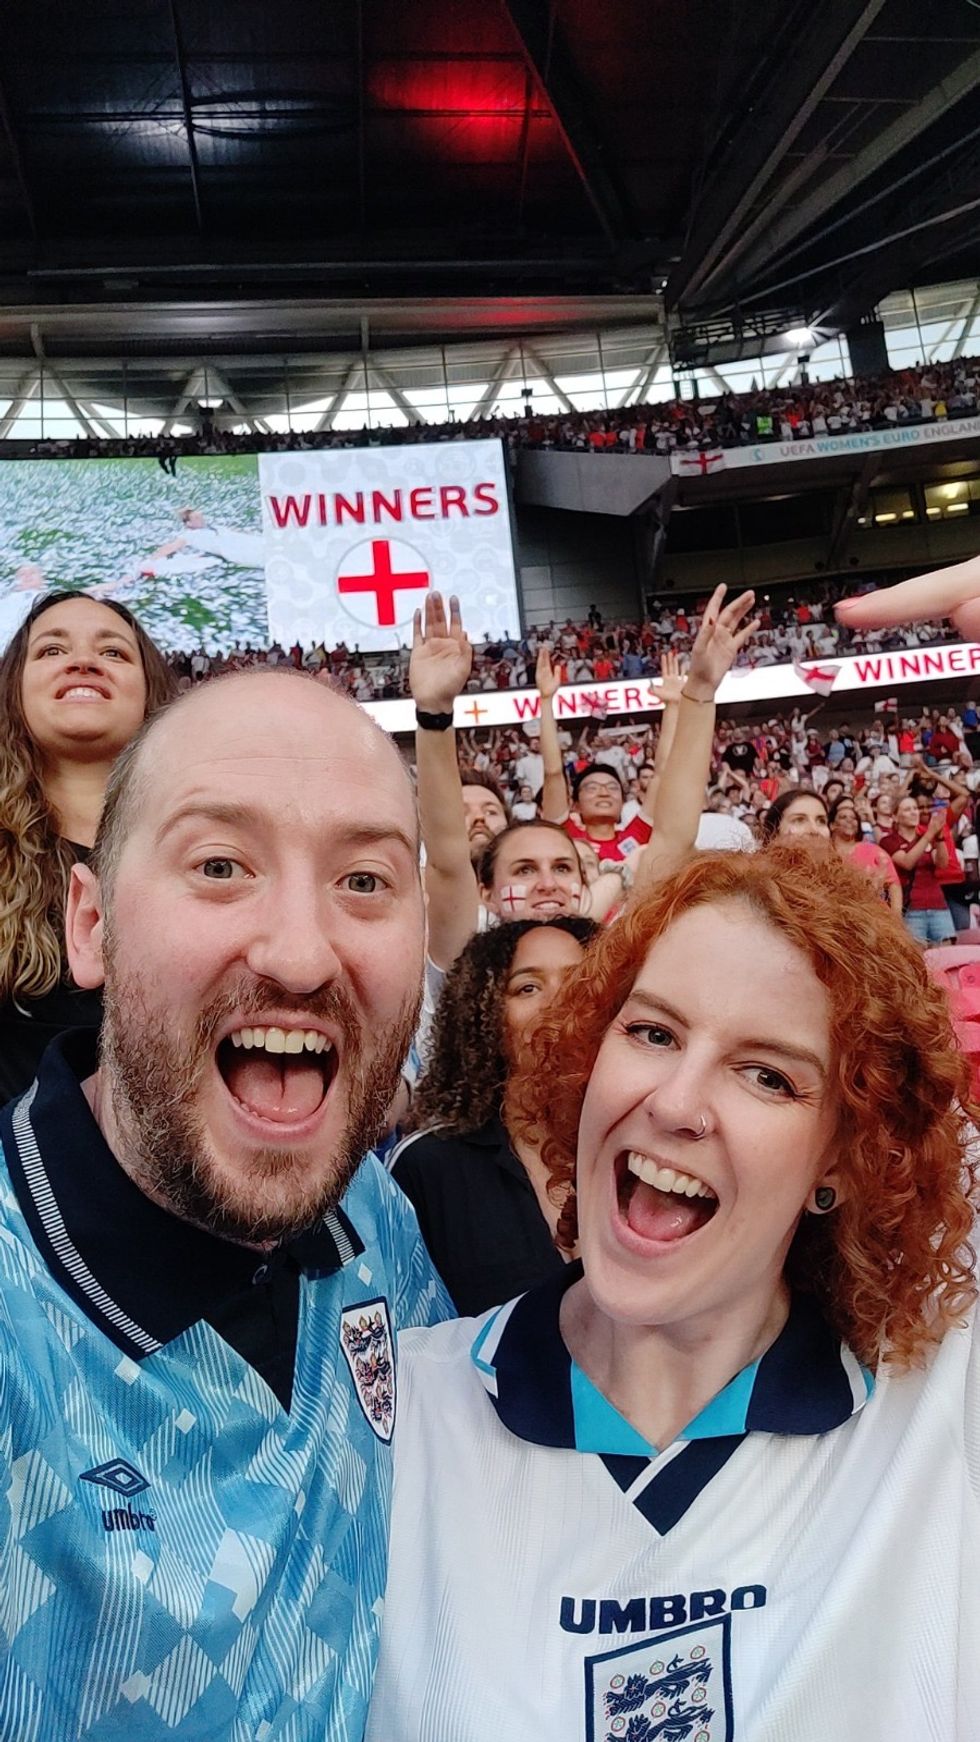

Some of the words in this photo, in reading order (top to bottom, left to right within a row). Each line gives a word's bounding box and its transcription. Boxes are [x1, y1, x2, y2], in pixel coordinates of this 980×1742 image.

[780, 444, 815, 457] UEFA
[816, 436, 880, 453] WOMEN'S
[883, 430, 920, 444] EURO
[269, 482, 500, 529] WINNERS
[513, 686, 664, 719] WNNERS
[560, 1584, 767, 1634] UMBRO
